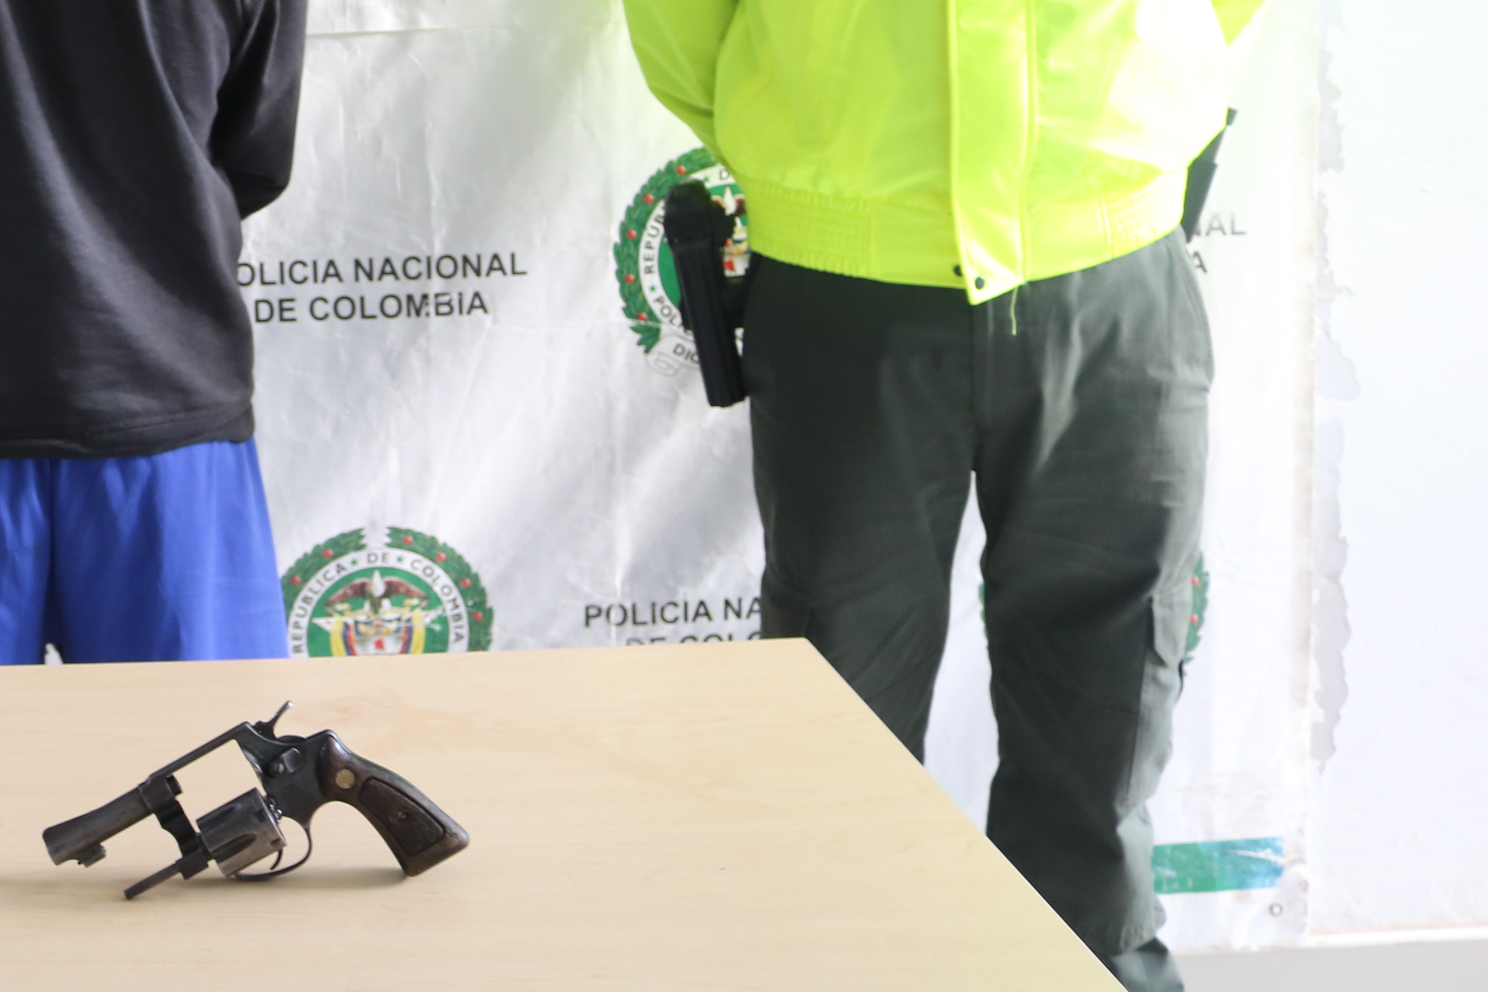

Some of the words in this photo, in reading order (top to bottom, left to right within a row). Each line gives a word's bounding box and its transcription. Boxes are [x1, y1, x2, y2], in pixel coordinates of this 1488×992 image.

[236, 258, 344, 288] OLICIA
[353, 251, 528, 283] NACIONAL
[253, 297, 298, 324] DE
[308, 290, 490, 322] COLOMBIA
[367, 552, 389, 564] DE
[411, 559, 465, 644] COLOMBIA
[583, 599, 714, 629] POLICIA
